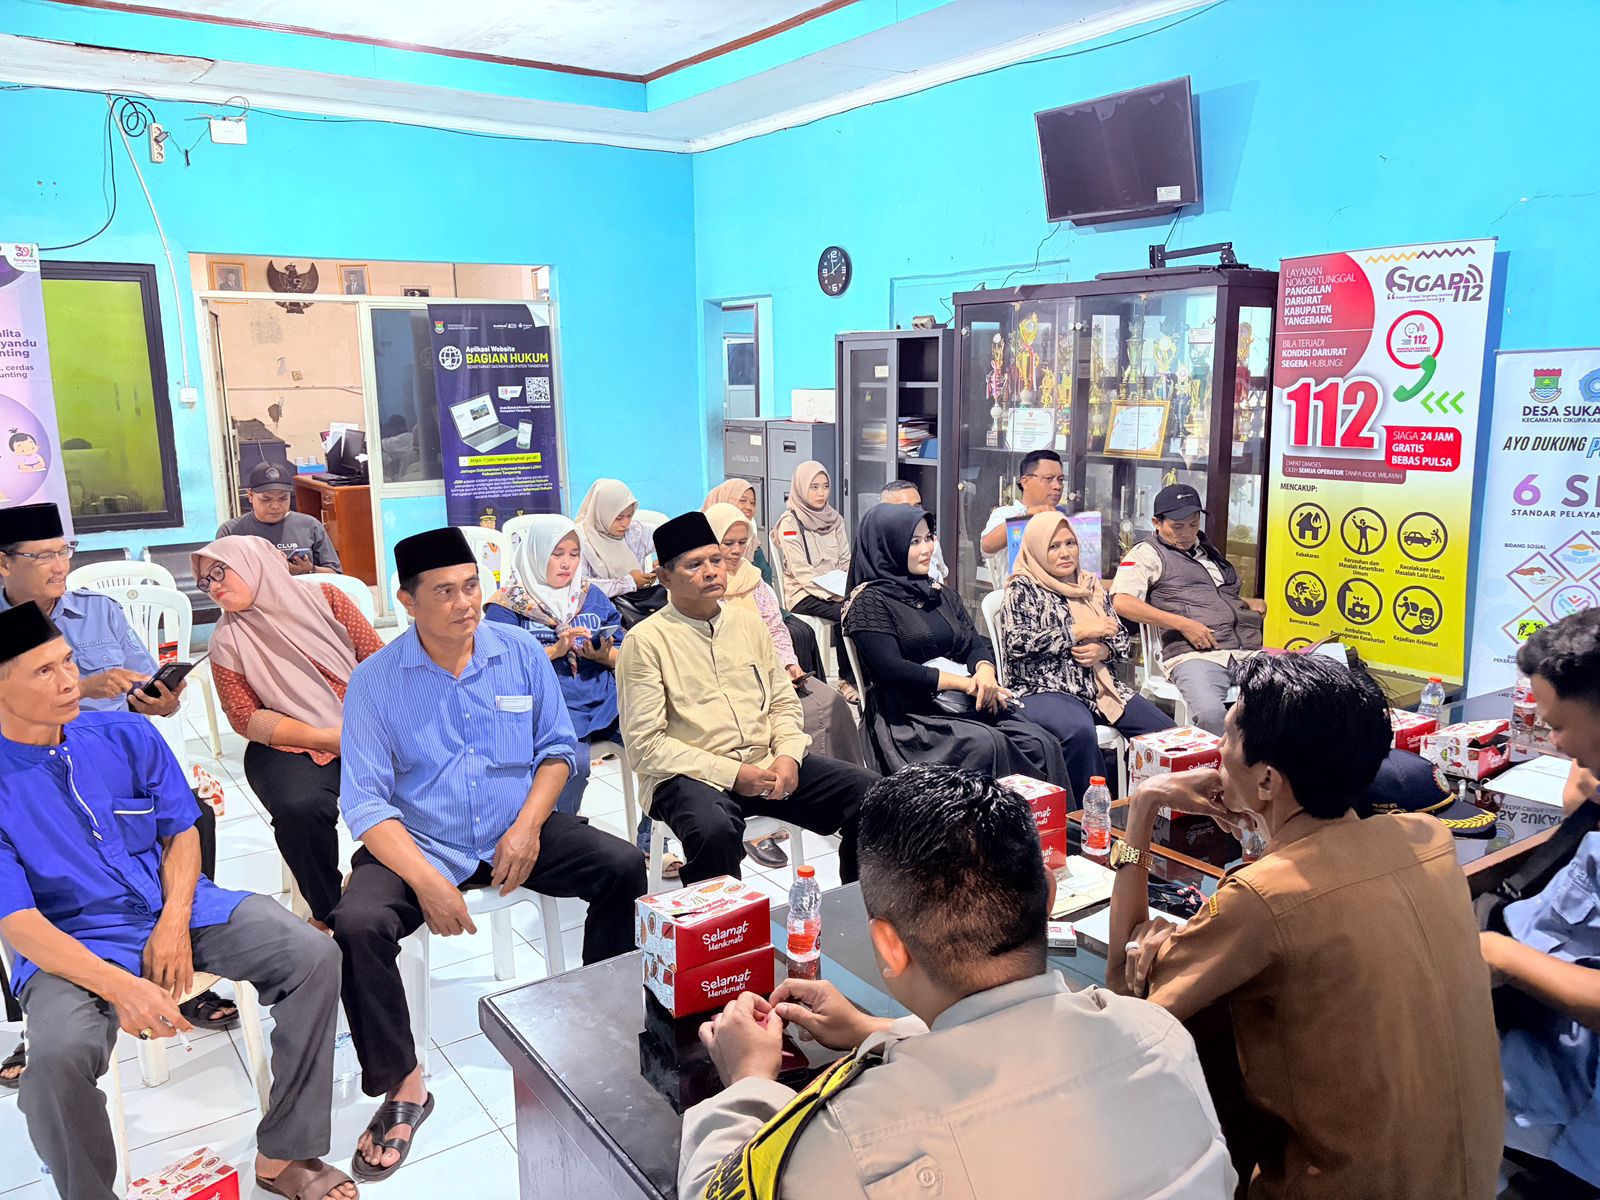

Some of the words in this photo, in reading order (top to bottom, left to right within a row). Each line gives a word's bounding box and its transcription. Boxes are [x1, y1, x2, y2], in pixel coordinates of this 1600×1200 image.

[1286, 266, 1322, 278] LAYANAN
[1285, 277, 1316, 287] NOMOR
[1318, 273, 1356, 284] TUNGGAL
[1285, 285, 1332, 296] PANGGILAN
[1453, 284, 1484, 302] 112
[1284, 295, 1322, 306] DARURAT
[1284, 305, 1332, 316] KABUPATEN
[1284, 315, 1333, 326] TANGERANG
[1282, 340, 1296, 348] BILA
[1298, 339, 1325, 347] TERJADI
[1413, 335, 1428, 345] 112
[466, 345, 490, 353] Aplikasi
[1281, 349, 1311, 358] KONDISI
[1312, 347, 1348, 356] DARURAT
[466, 353, 508, 364] BAGIAN
[510, 352, 549, 364] HUKUM
[1281, 359, 1308, 368] SEGERA
[1309, 358, 1344, 367] HUBUNGI:
[1286, 379, 1379, 449] 112
[1522, 406, 1559, 417] DESA
[1393, 431, 1419, 441] SIAGA
[1420, 431, 1433, 441] 24
[1434, 432, 1454, 441] JAM
[1392, 443, 1425, 453] GRATIS
[1502, 436, 1531, 451] AYO
[1531, 436, 1588, 452] DUKUNG
[1391, 455, 1421, 466] BEBAS
[1422, 456, 1453, 467] PULSA
[1317, 468, 1344, 476] OPERATOR
[1377, 472, 1403, 480] WILAYAH
[1280, 483, 1318, 493] MENCAKUP:
[1512, 473, 1542, 507] 6
[1511, 509, 1556, 518] STANDAR
[1295, 551, 1320, 559] Kebakaran
[1343, 557, 1369, 565] Kerusuhan
[1358, 565, 1385, 573] Ketertiban
[1399, 564, 1430, 573] Kecelakaan
[1394, 569, 1416, 578] Masalah
[1416, 571, 1428, 579] Lalu
[1428, 573, 1445, 581] Lintas
[1288, 617, 1308, 626] Bencana
[1344, 627, 1373, 637] Ambulance,
[1359, 634, 1386, 645] Kesehatan
[1393, 635, 1416, 645] Kejadian
[1416, 639, 1439, 648] Kriminal
[701, 920, 750, 945] Selamat
[708, 935, 744, 952] Menikmati
[700, 968, 752, 992] Selamat
[707, 982, 746, 999] Menikmati
